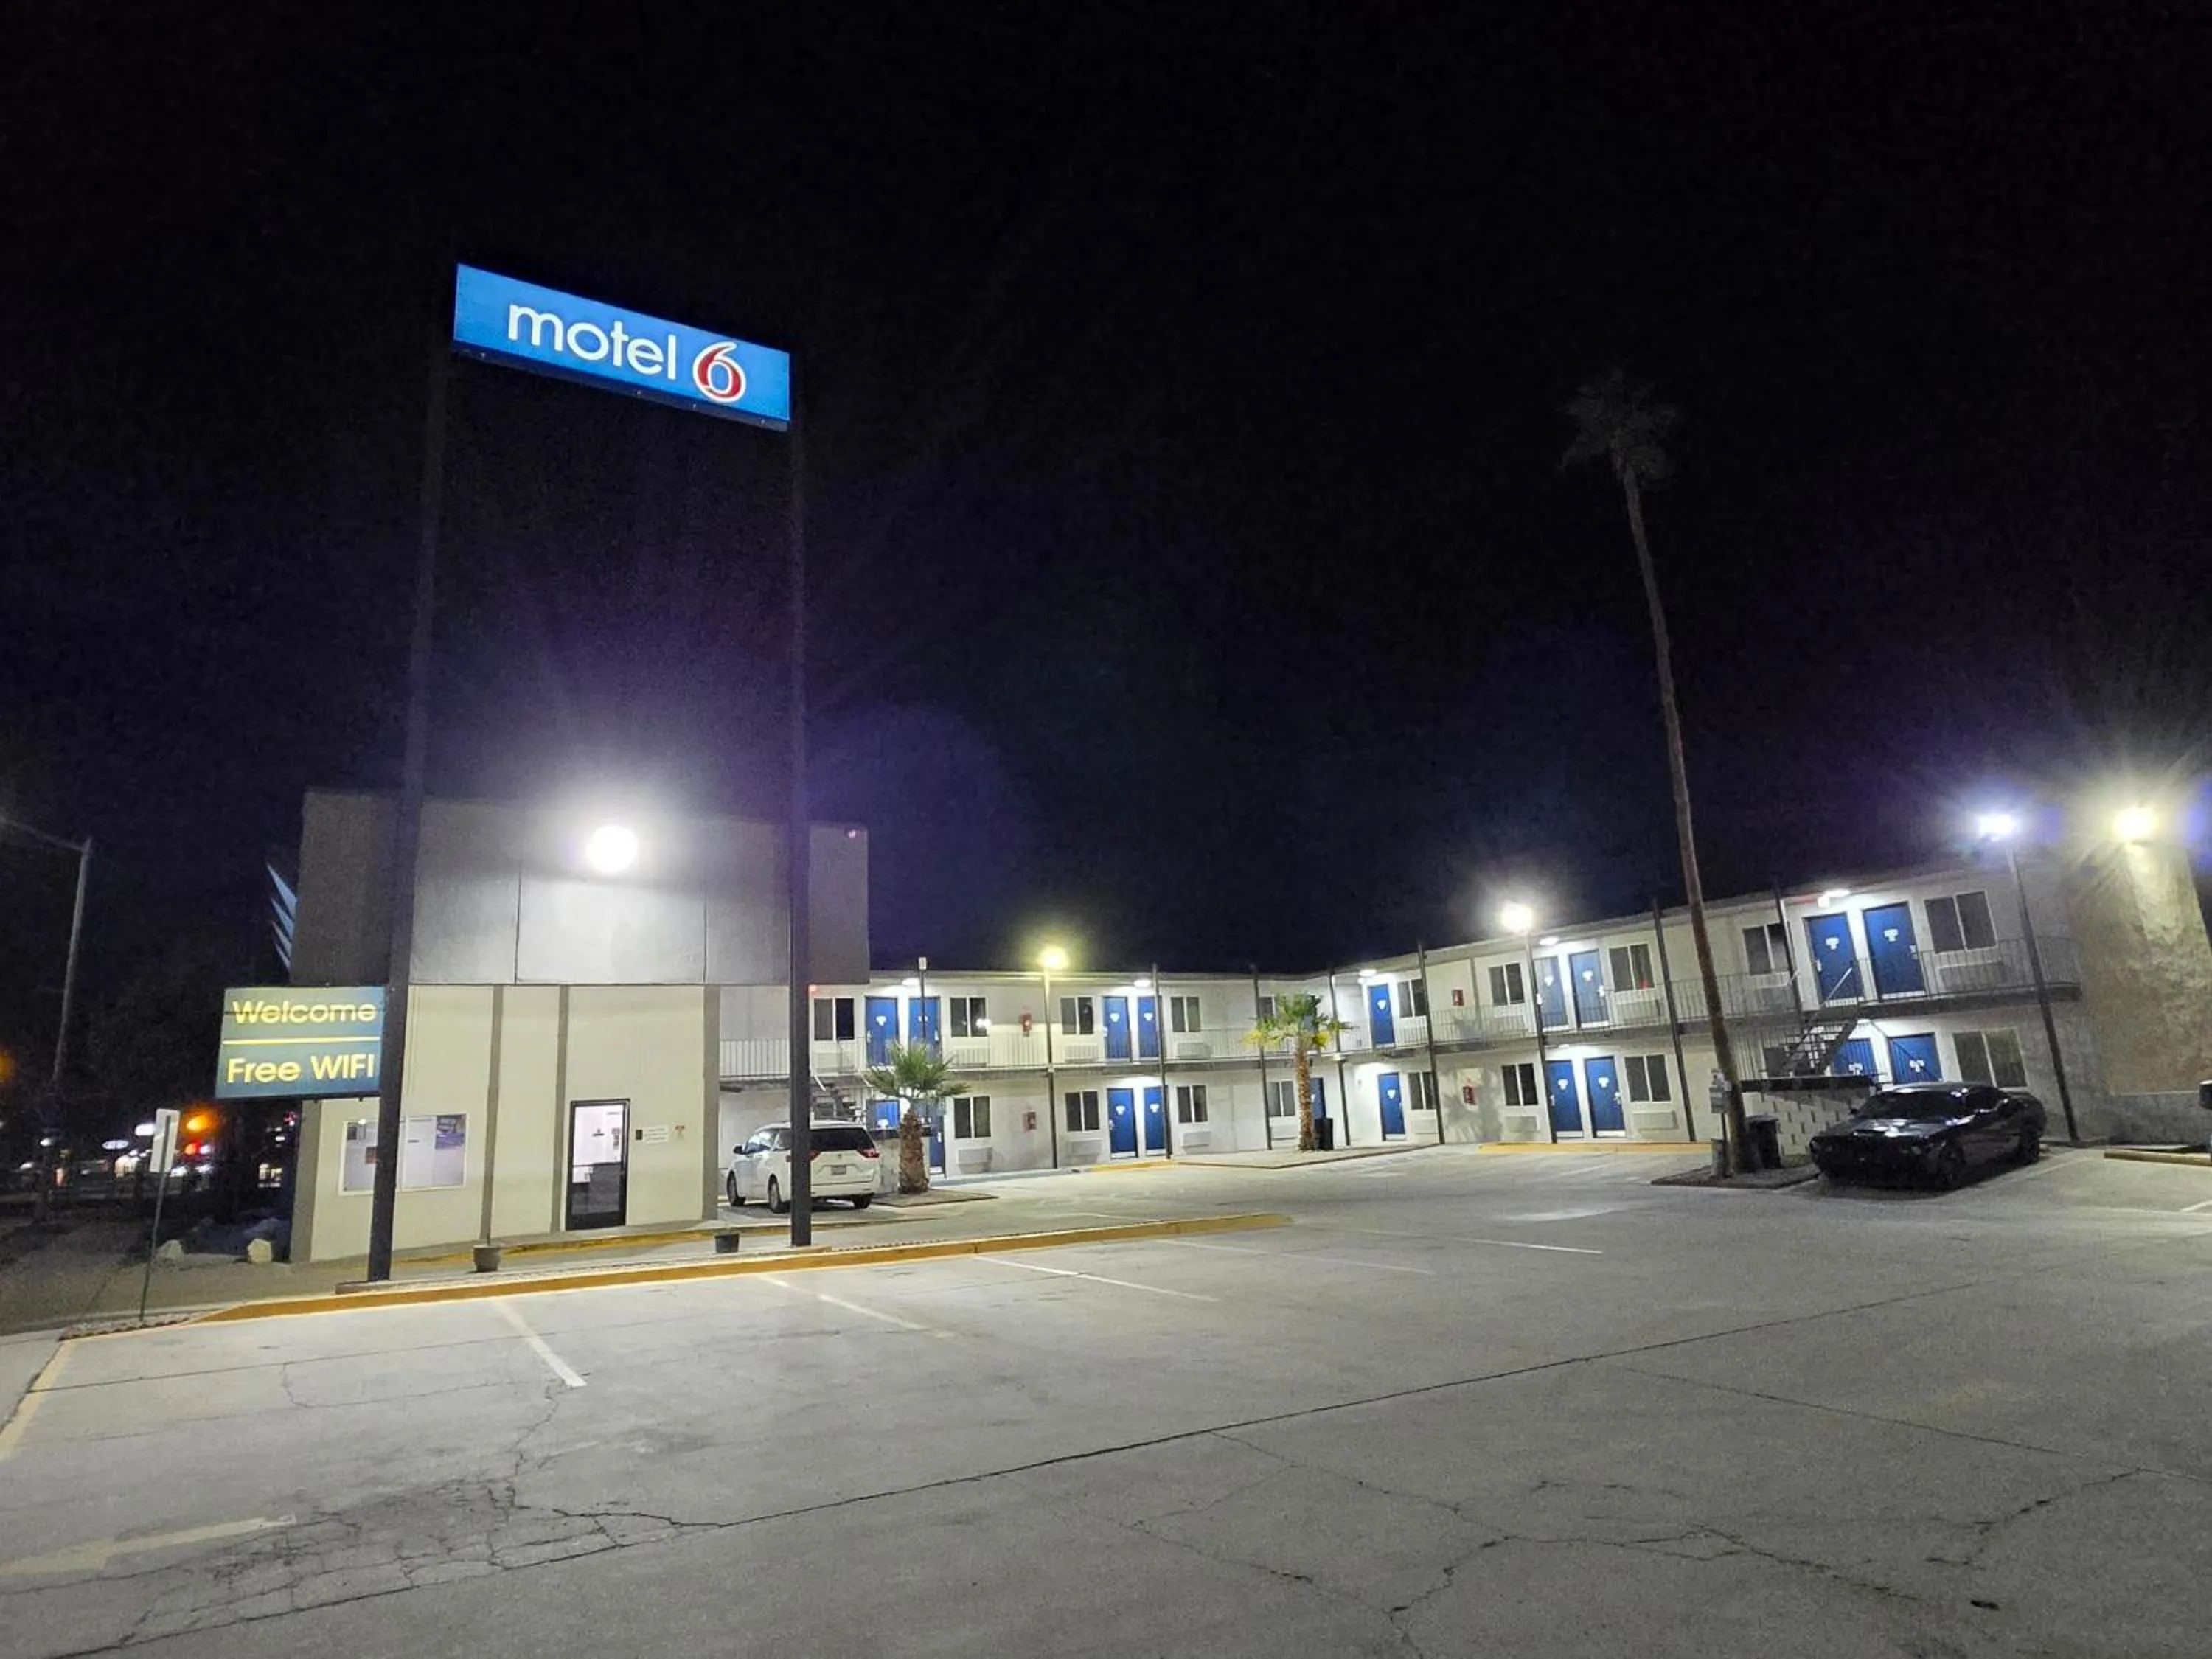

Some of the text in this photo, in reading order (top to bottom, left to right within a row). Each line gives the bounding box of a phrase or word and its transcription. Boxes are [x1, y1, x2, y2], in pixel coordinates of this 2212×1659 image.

[507, 304, 746, 403] motel 6
[232, 1000, 378, 1024] Welcome
[226, 1054, 375, 1084] Free WIFI
